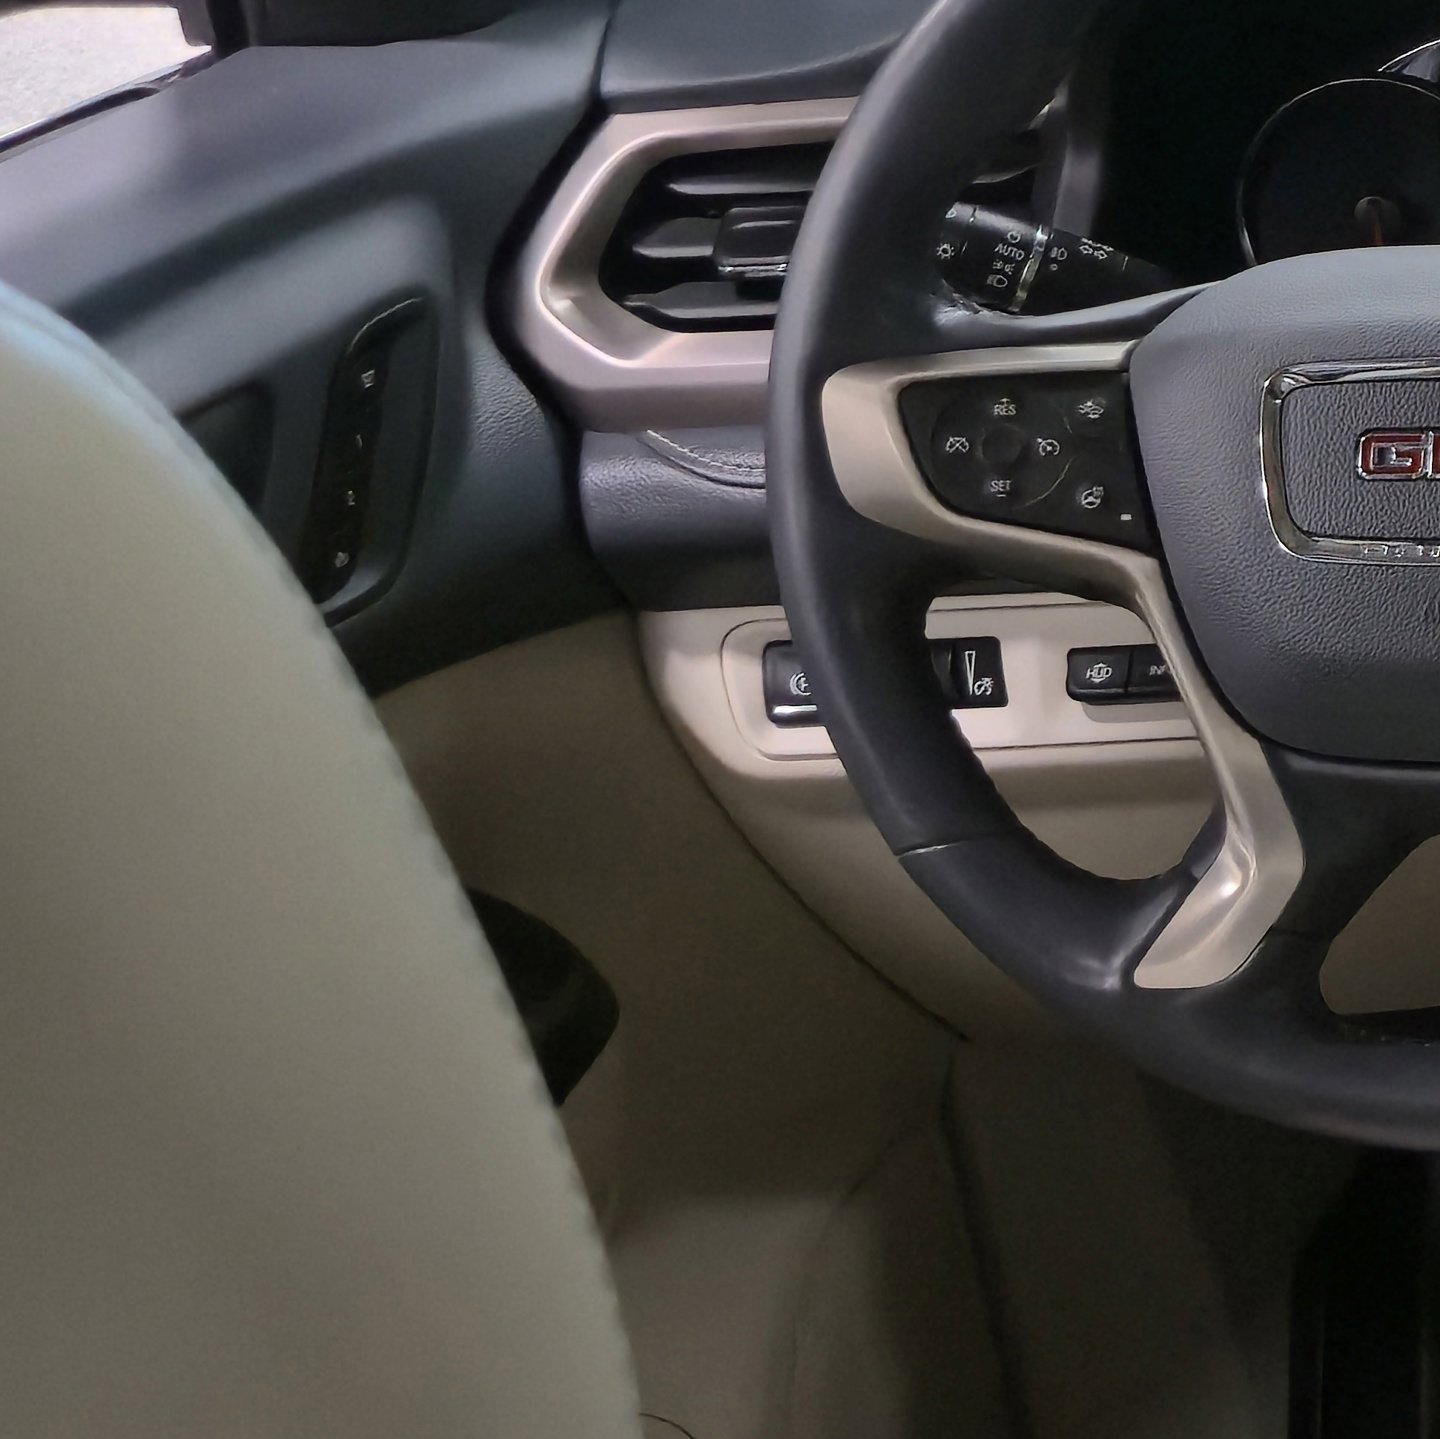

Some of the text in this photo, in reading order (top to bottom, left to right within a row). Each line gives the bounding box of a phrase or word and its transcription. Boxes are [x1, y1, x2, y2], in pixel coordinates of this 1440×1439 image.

[994, 242, 1025, 261] AUTO
[993, 403, 1017, 416] RES
[990, 479, 1013, 492] SET
[1085, 665, 1112, 680] HUD
